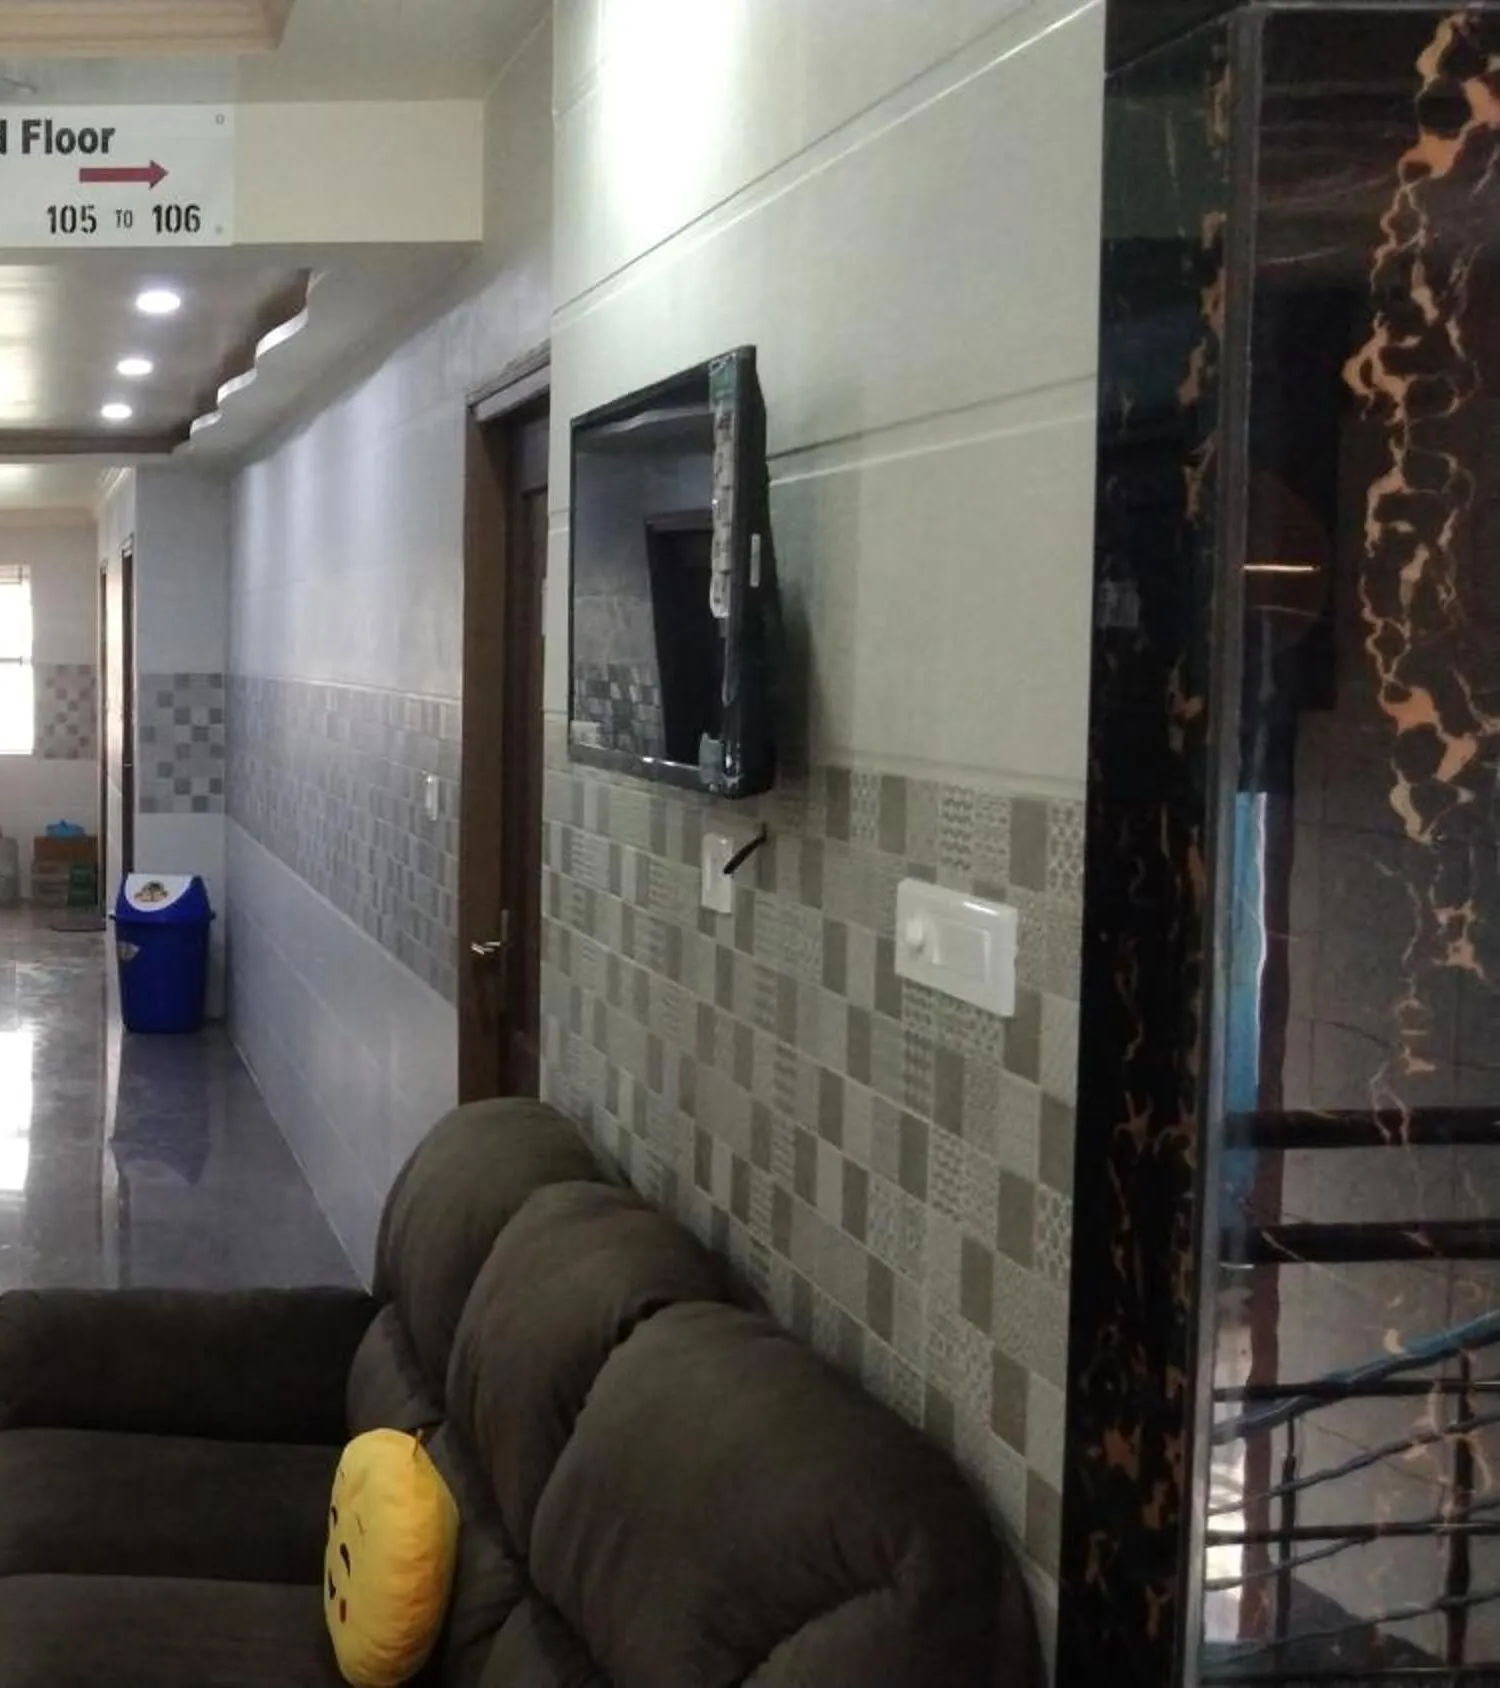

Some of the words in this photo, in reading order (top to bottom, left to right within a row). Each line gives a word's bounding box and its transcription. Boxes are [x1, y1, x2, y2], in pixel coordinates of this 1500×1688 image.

[21, 118, 116, 156] Floor
[47, 204, 98, 234] 105
[115, 209, 133, 229] TO
[152, 203, 201, 234] 106
